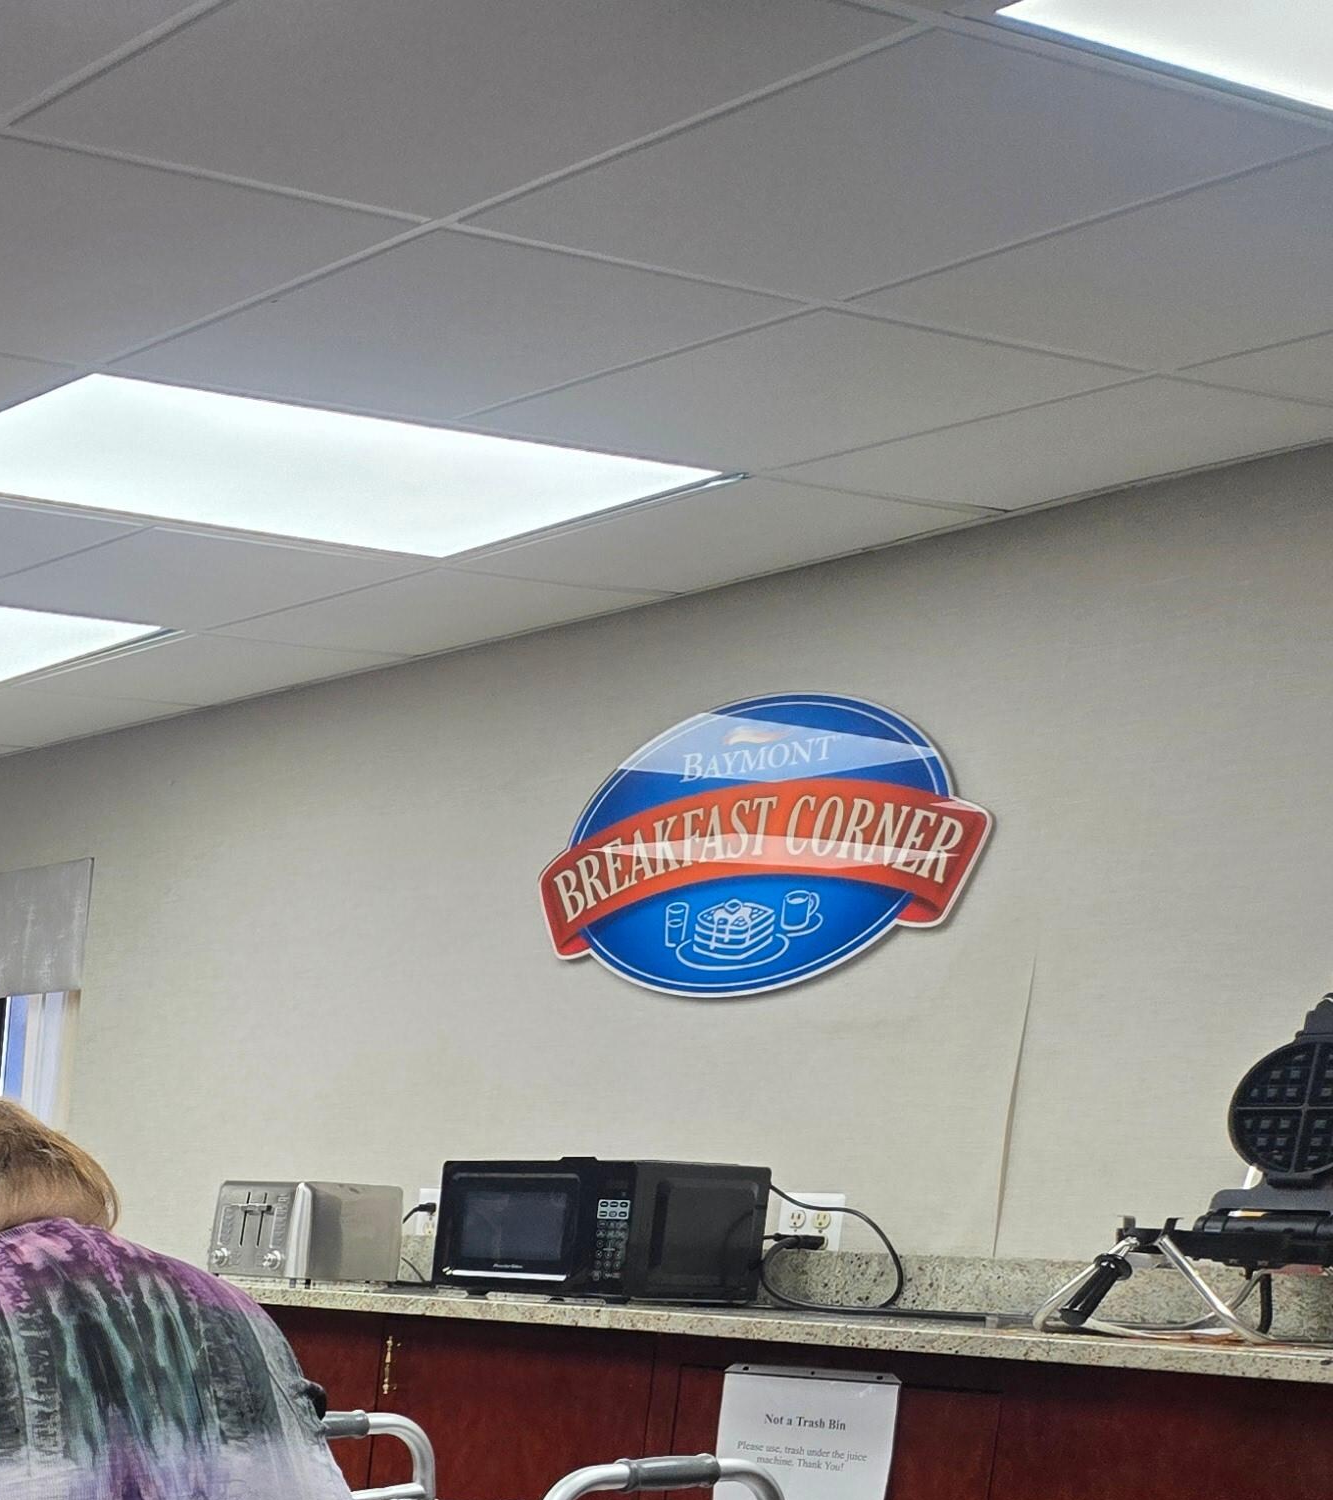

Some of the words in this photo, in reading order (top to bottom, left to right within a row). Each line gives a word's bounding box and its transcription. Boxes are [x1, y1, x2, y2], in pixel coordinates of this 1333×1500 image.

[680, 735, 838, 783] BAYMONT
[553, 796, 778, 924] BREAKFAST
[786, 795, 964, 884] CORNER
[764, 1414, 783, 1424] Not
[786, 1417, 793, 1426] a
[796, 1416, 825, 1429] Trash
[828, 1418, 846, 1431] Bin
[737, 1440, 764, 1452] Please
[784, 1445, 805, 1456] trash
[807, 1448, 830, 1458] under
[832, 1449, 845, 1460] the
[845, 1451, 867, 1462] juice
[797, 1458, 822, 1469] Thank
[824, 1460, 845, 1472] You!
